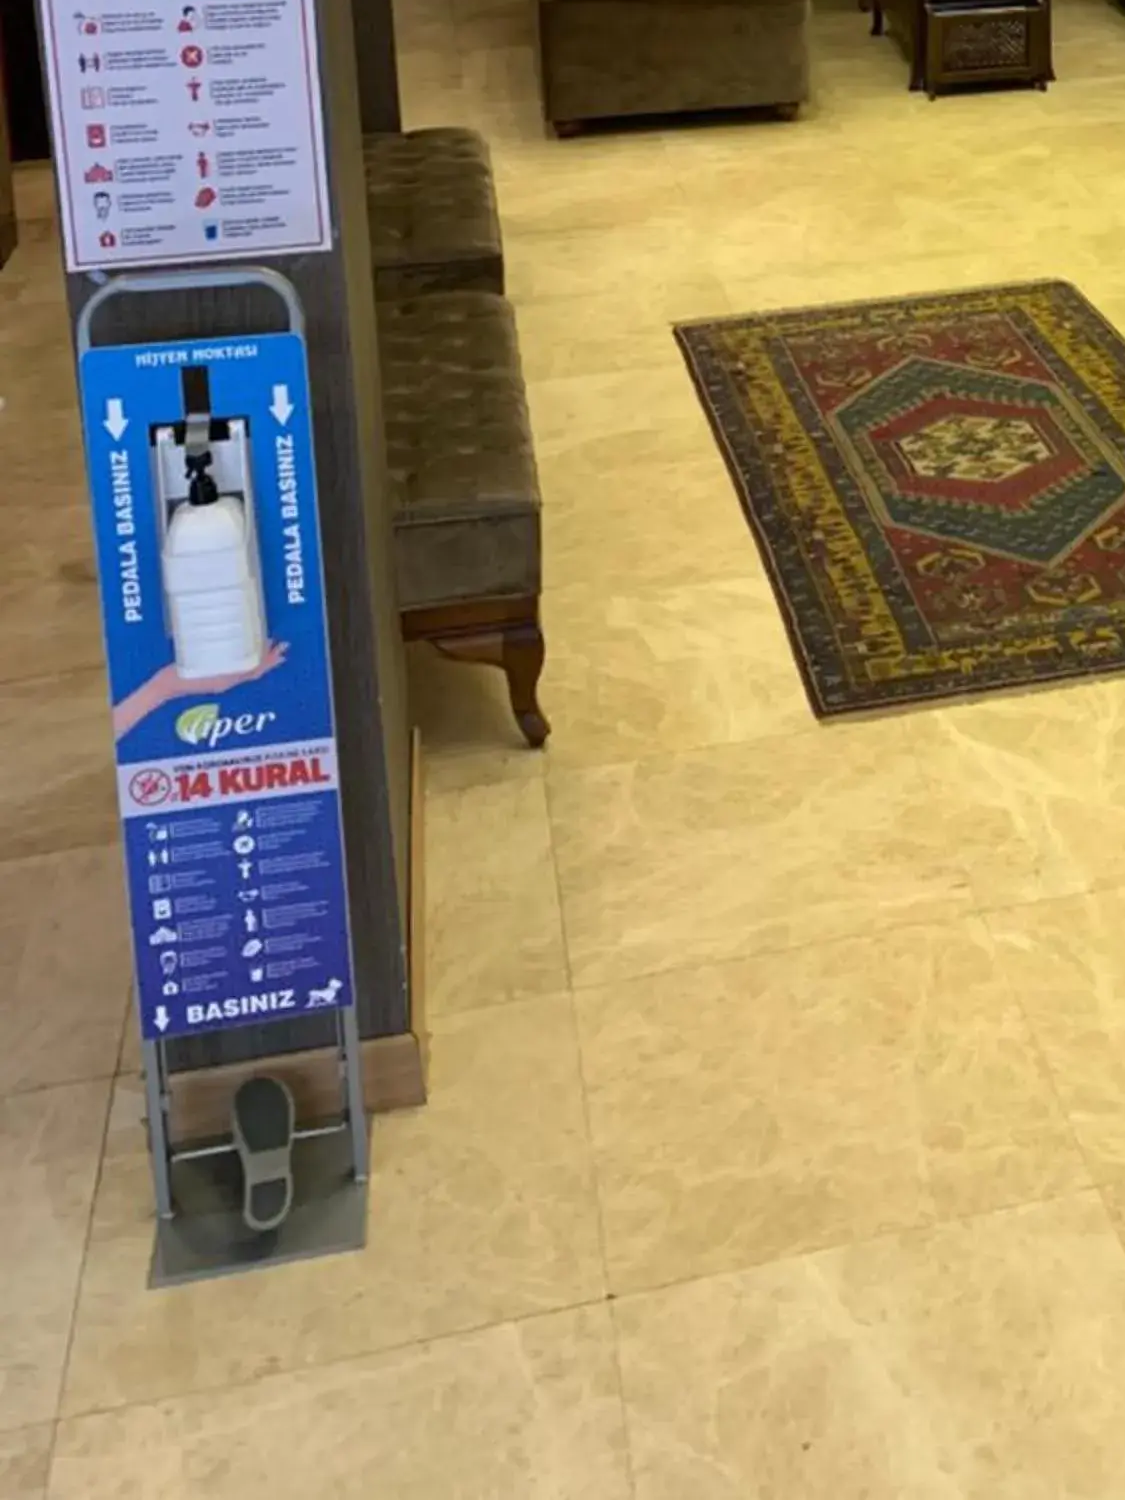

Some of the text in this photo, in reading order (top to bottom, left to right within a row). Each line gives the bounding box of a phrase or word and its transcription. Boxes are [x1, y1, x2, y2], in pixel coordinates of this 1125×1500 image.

[109, 449, 143, 623] PEDALA BASINIZ
[275, 434, 306, 605] PEDALA BASINIZ
[175, 771, 213, 803] 14
[219, 757, 331, 796] KURAL
[186, 988, 297, 1025] BASINIZ
